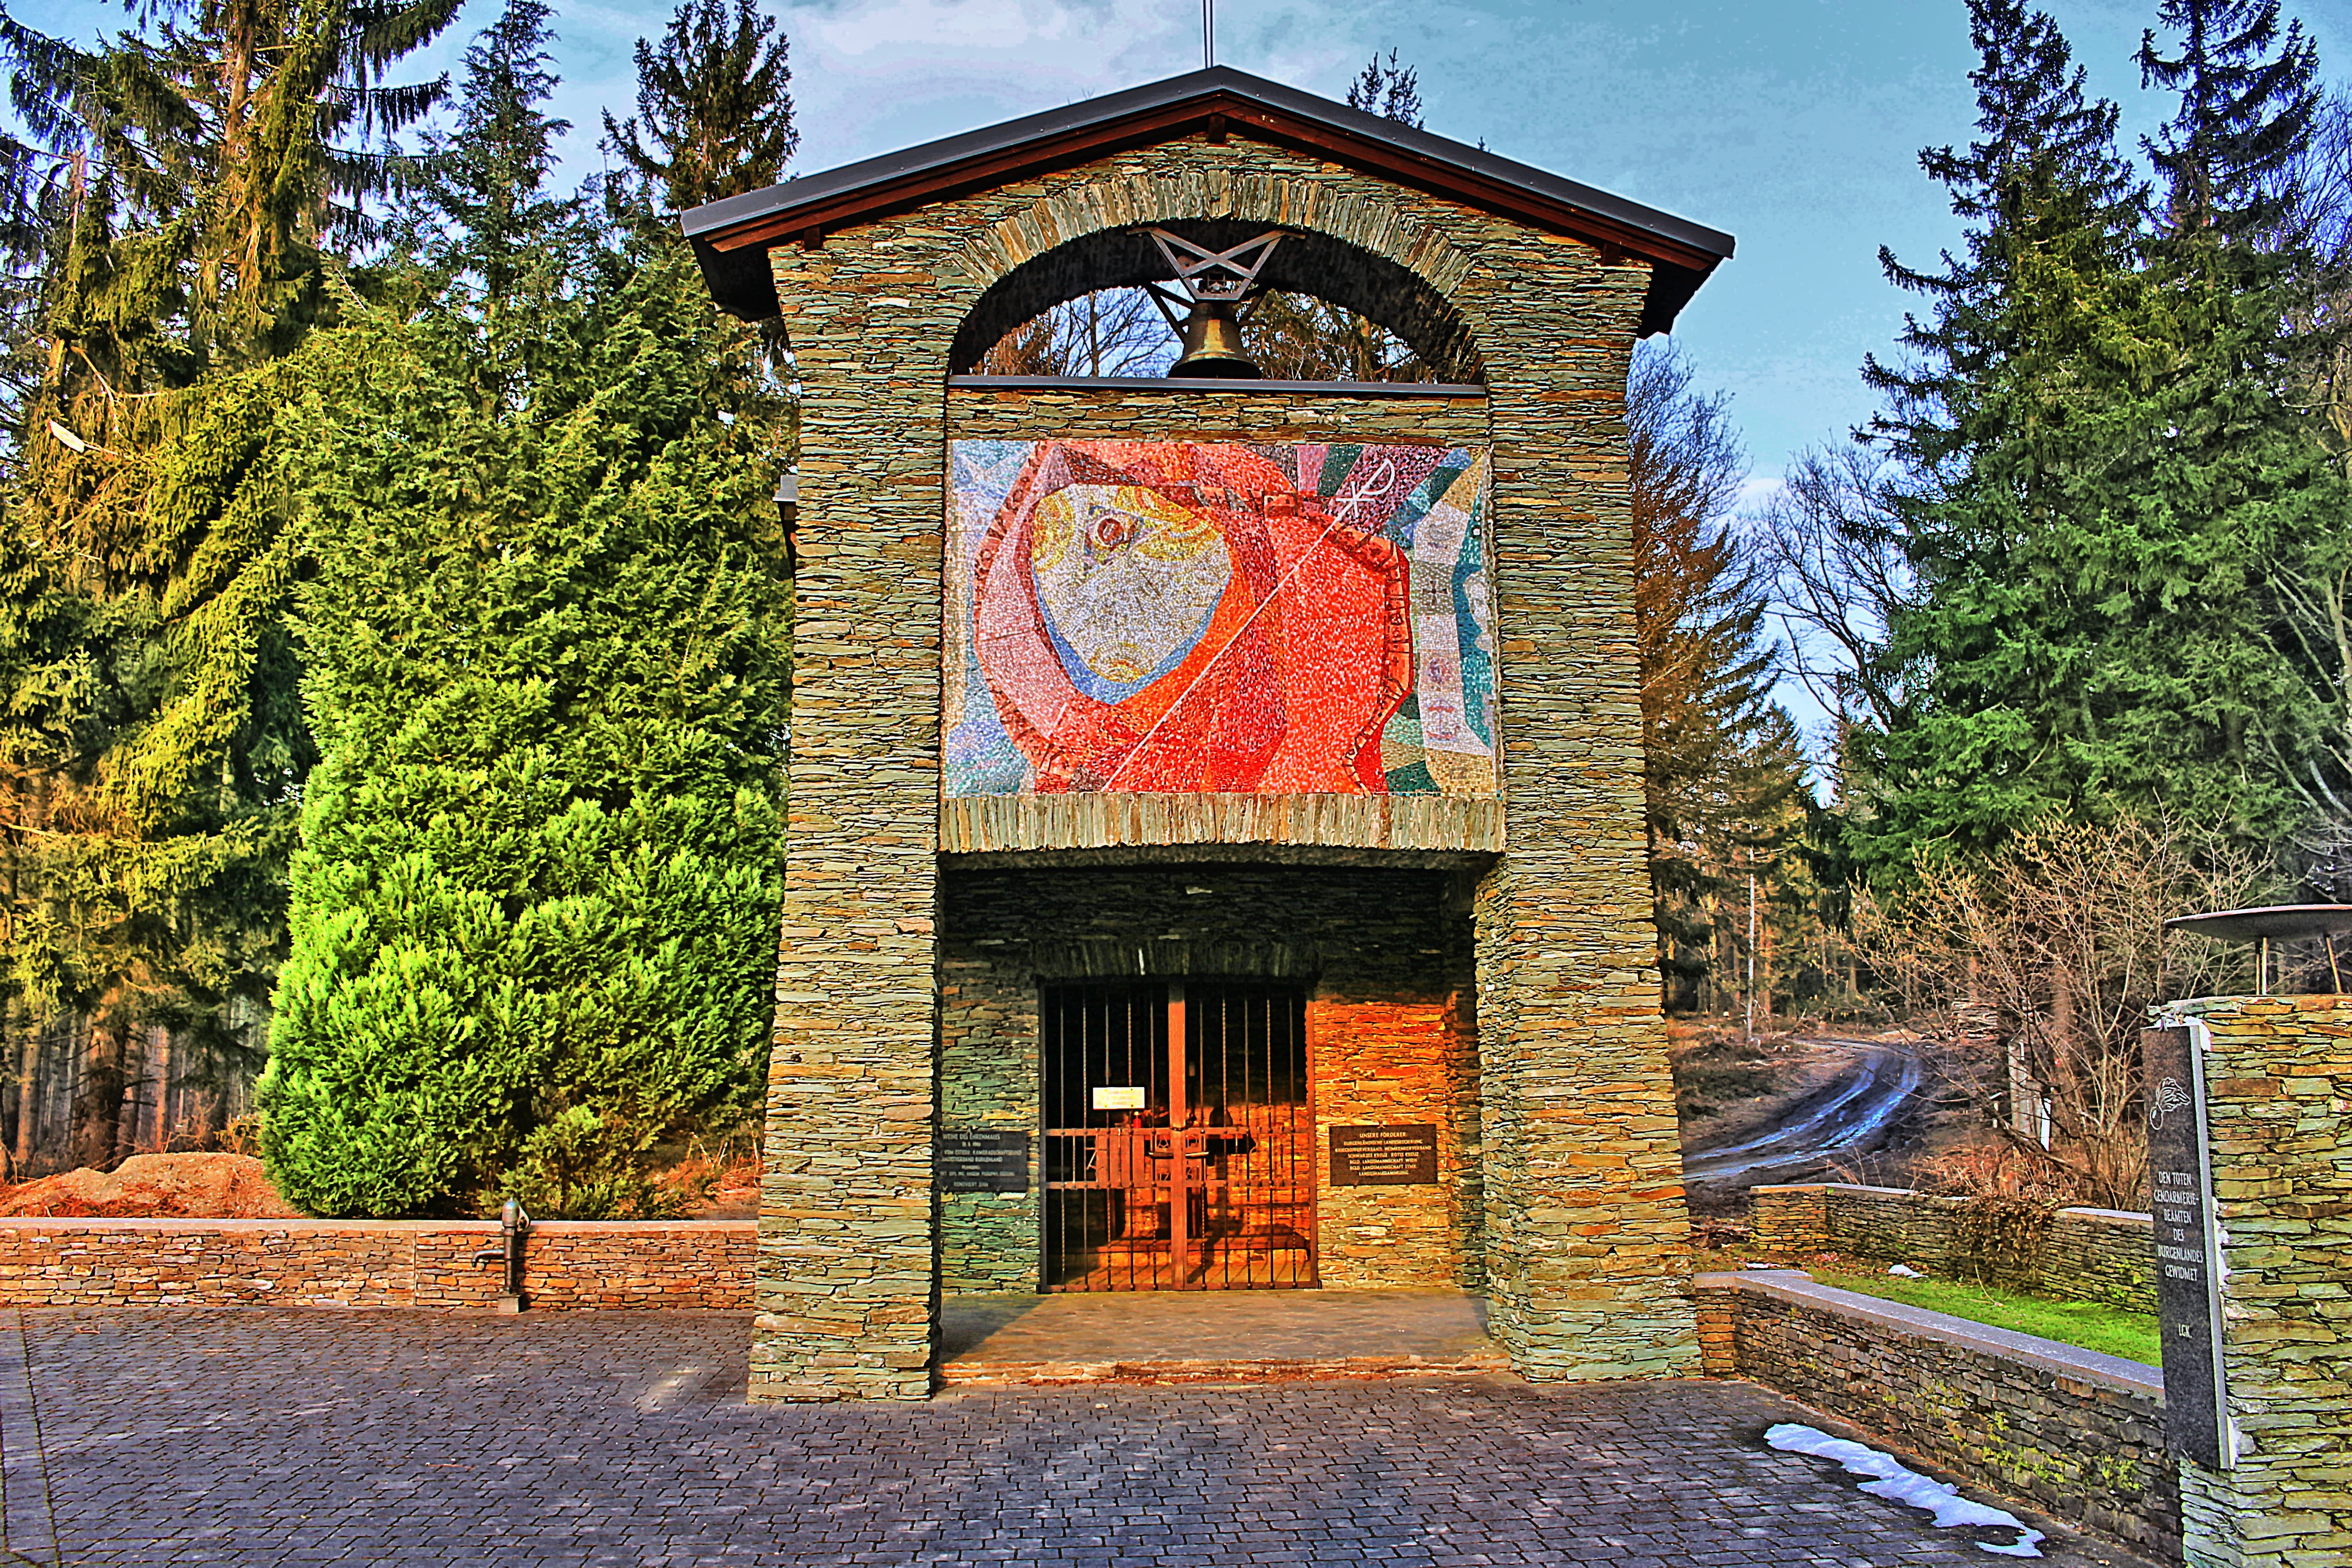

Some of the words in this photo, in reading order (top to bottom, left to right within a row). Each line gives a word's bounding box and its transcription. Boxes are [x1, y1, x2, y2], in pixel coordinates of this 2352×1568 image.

[2158, 1171, 2171, 1184] DEN
[2172, 1172, 2191, 1186] TOTEN
[2154, 1190, 2200, 1205] GENDARMERIE-
[2163, 1208, 2191, 1224] BEAMTEN
[2173, 1228, 2184, 1241] DES
[2157, 1245, 2203, 1263] BURGENLANDES
[2165, 1264, 2197, 1281] GEWIDMET
